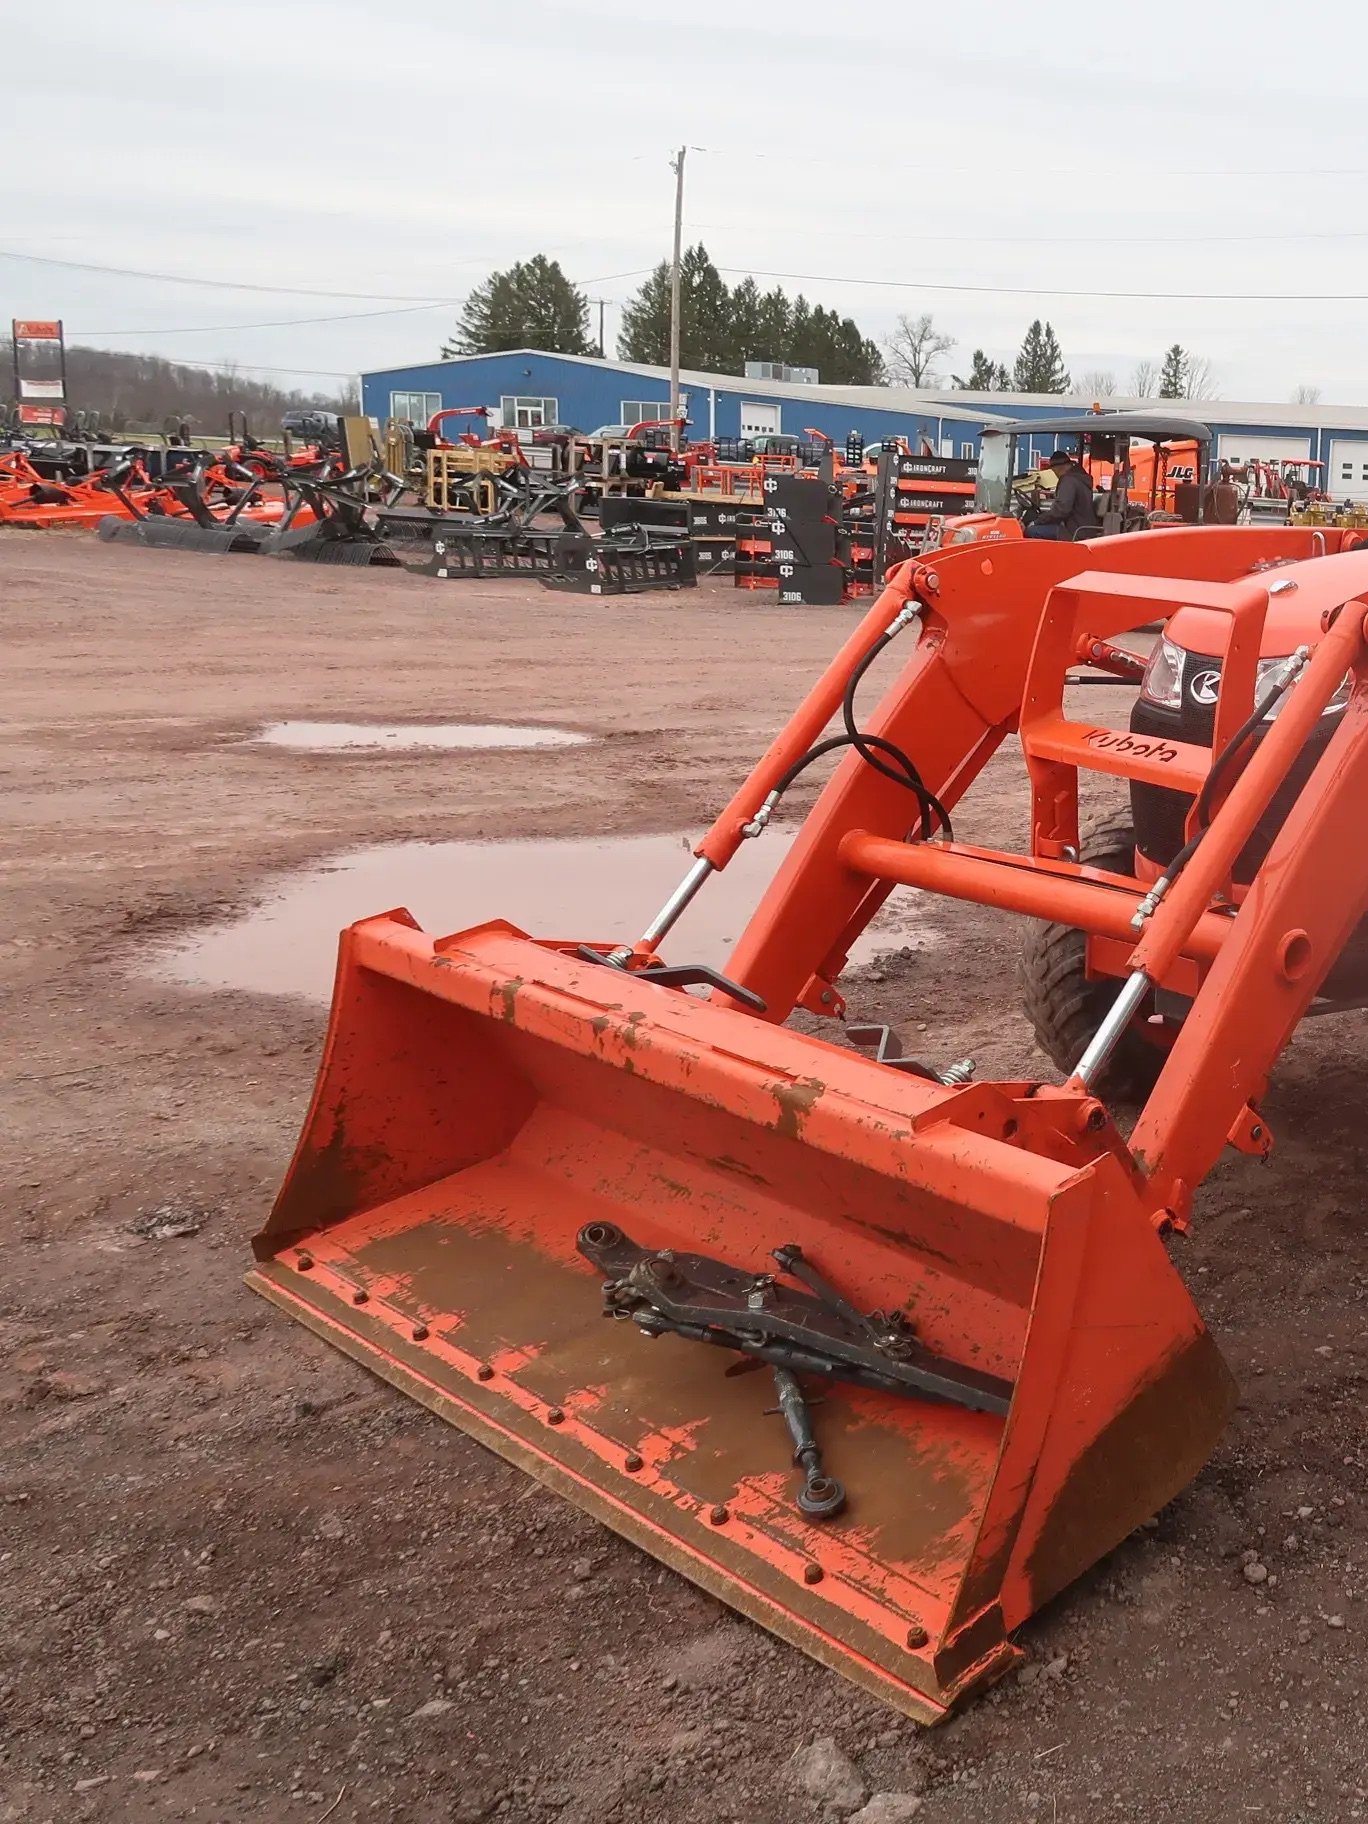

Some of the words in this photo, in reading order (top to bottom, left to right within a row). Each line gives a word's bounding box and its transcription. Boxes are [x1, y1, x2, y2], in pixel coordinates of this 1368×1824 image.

[913, 464, 946, 473] IRONCRAFT
[967, 467, 977, 475] 310
[1166, 466, 1195, 479] JLG
[910, 500, 943, 508] IRONCRAFT
[964, 500, 974, 508] 310
[775, 550, 793, 560] 3106
[783, 592, 802, 601] 3106
[1081, 729, 1178, 762] Kubota
